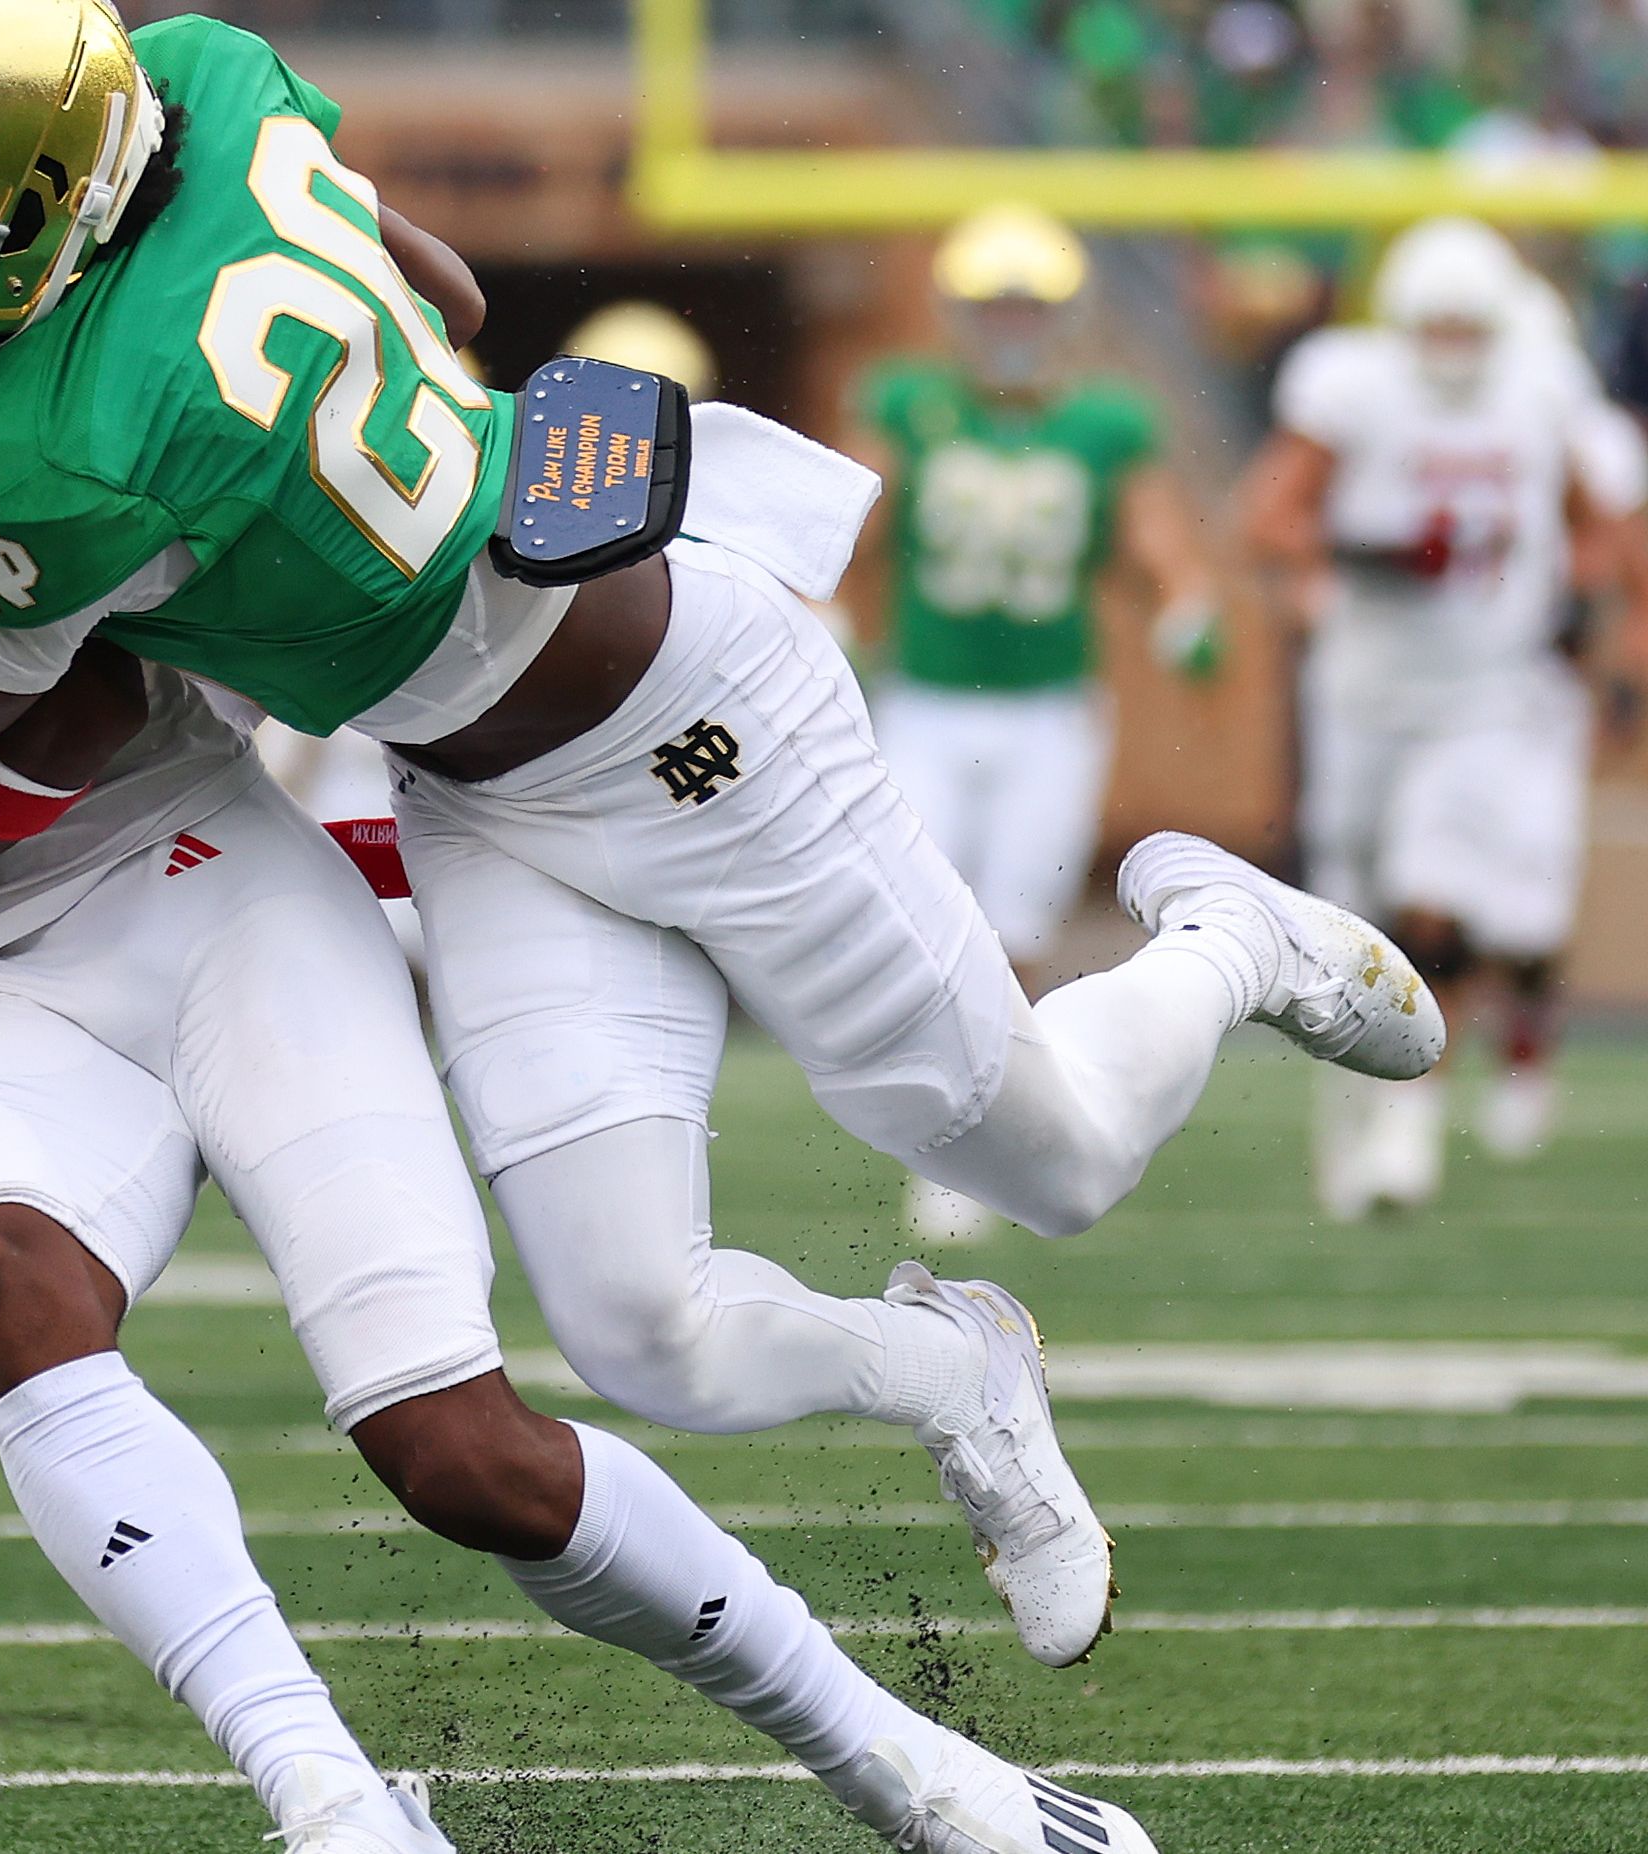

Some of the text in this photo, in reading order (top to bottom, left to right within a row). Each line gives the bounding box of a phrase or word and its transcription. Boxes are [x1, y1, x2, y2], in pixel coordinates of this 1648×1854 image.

[198, 116, 493, 582] 20
[546, 427, 568, 459] LIKE
[571, 414, 602, 510] A CHAMPION
[604, 432, 632, 488] TODAY
